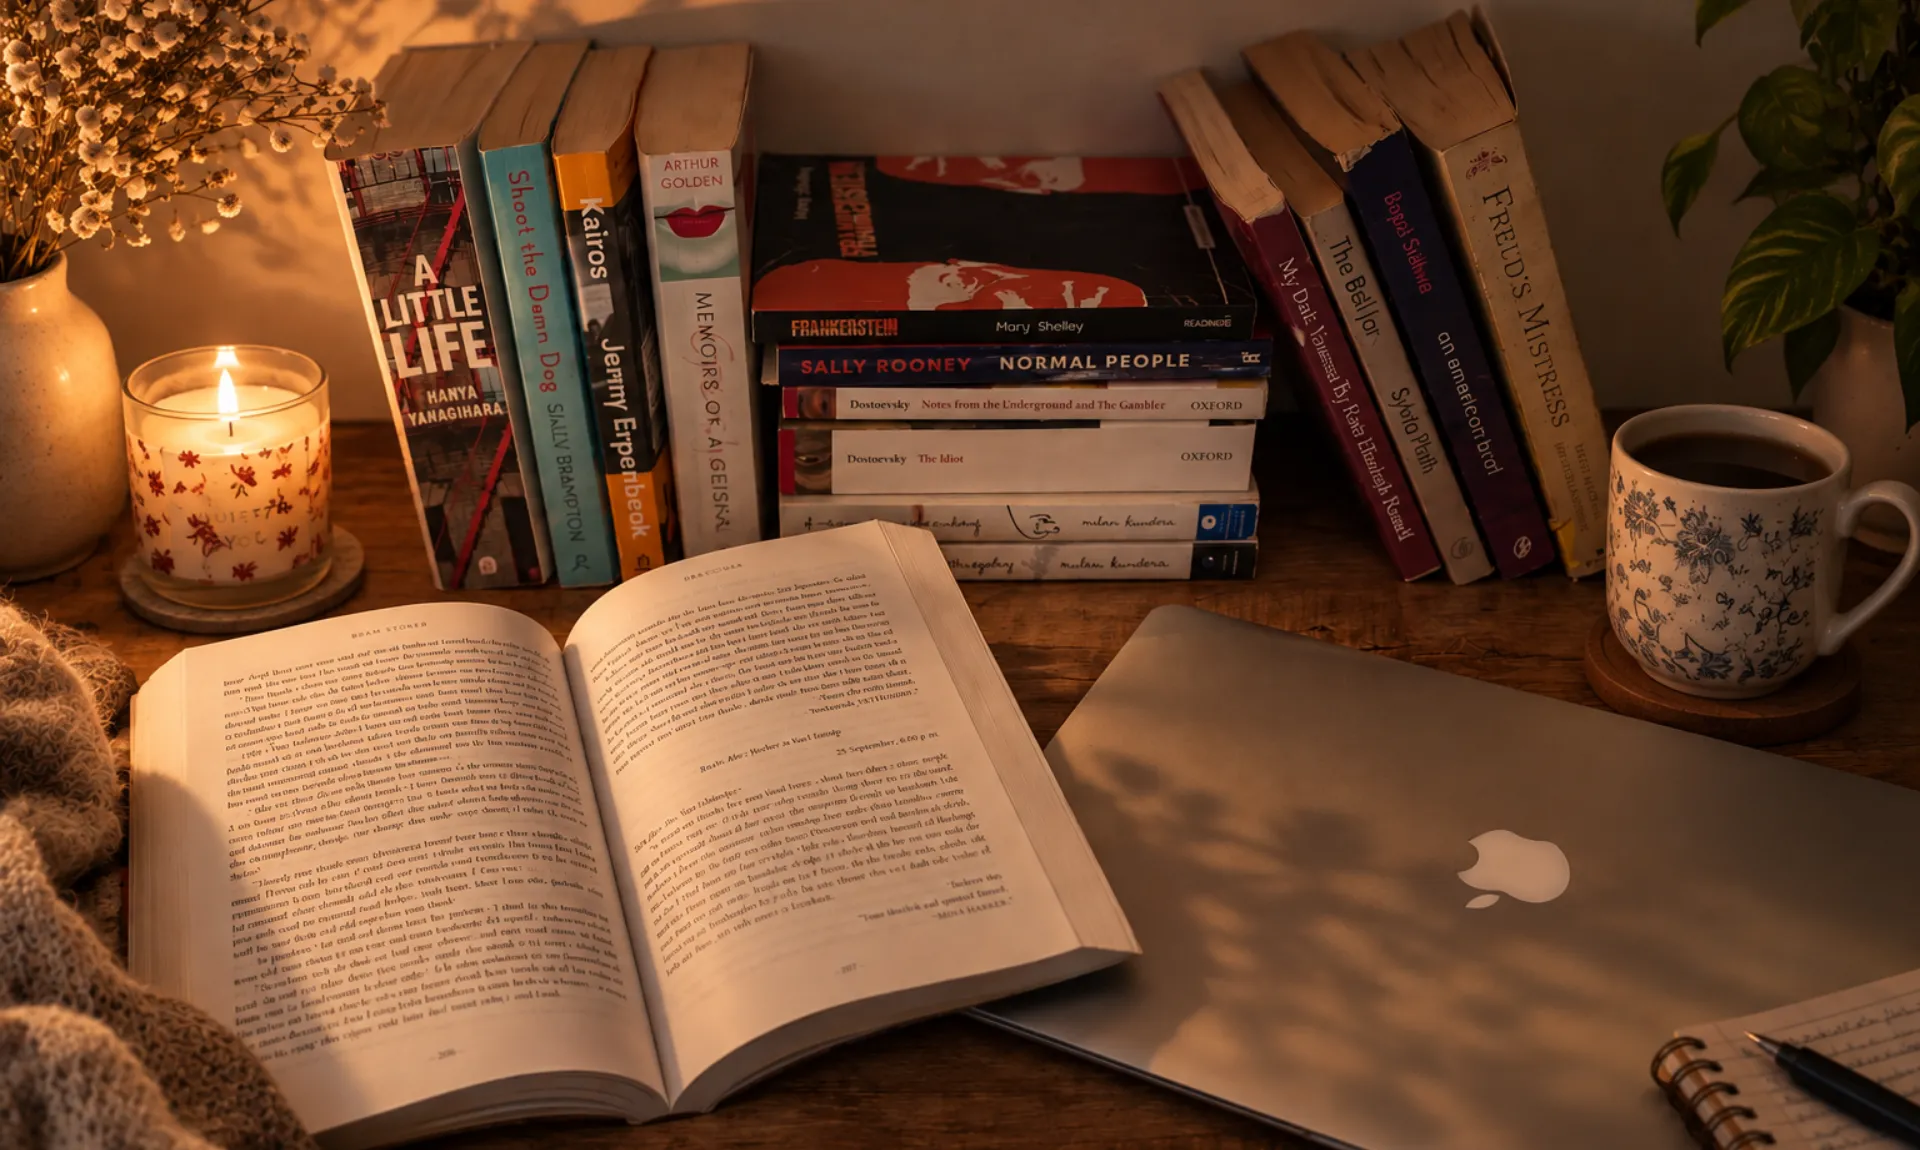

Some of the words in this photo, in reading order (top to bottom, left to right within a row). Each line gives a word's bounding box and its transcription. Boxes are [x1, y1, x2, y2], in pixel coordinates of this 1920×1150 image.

[663, 156, 720, 171] ARTHUR
[660, 174, 723, 189] GOLDEN
[508, 169, 535, 238] Shoot
[578, 196, 608, 280] Kairos
[520, 241, 541, 278] the
[1329, 234, 1354, 277] The
[414, 254, 439, 287] A
[1278, 256, 1300, 288] My
[379, 284, 483, 329] LITTLE
[996, 320, 1031, 335] Mary
[1037, 320, 1085, 334] Shelley
[389, 320, 493, 380] LIFE
[695, 292, 720, 392] MEMOIRS
[1437, 329, 1455, 355] an
[539, 352, 561, 393] Dog
[801, 359, 866, 375] SALLY
[876, 357, 972, 374] ROONEY
[1000, 354, 1097, 371] NORMAL
[1106, 353, 1190, 369] PEOPLE
[1517, 301, 1571, 429] MISTRESS
[426, 384, 478, 405] HANYA
[850, 400, 910, 412] Dostoevsky
[922, 400, 951, 409] Notes
[955, 399, 981, 409] from
[983, 399, 1000, 409] the
[1075, 400, 1095, 410] and
[1097, 400, 1117, 410] The
[1190, 401, 1243, 411] OXFORD
[407, 402, 504, 428] YANAGIHARA
[847, 454, 907, 466] Dostoevsky
[918, 454, 937, 464] The
[939, 454, 964, 464] Idiot
[1181, 452, 1233, 462] OXFORD
